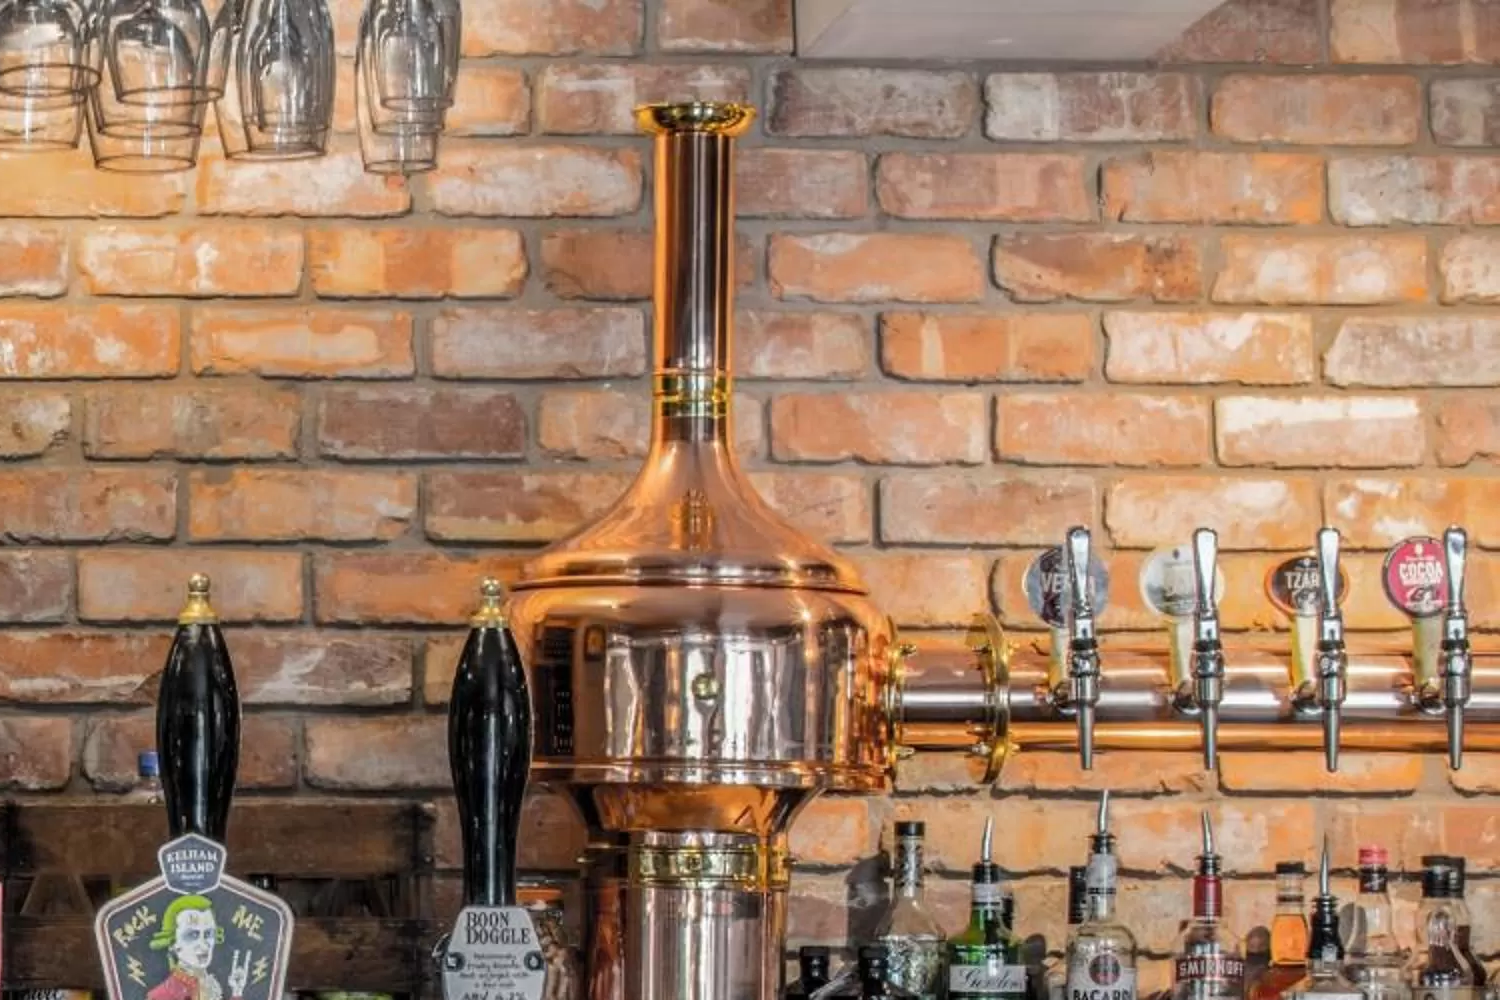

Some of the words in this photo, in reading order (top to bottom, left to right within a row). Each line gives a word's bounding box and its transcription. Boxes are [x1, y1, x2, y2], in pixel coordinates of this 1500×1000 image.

[1398, 561, 1444, 581] COCOA
[166, 849, 219, 863] KELHAM
[170, 861, 215, 874] ISLAND
[465, 911, 510, 928] BOON
[465, 927, 531, 945] DOGGLE
